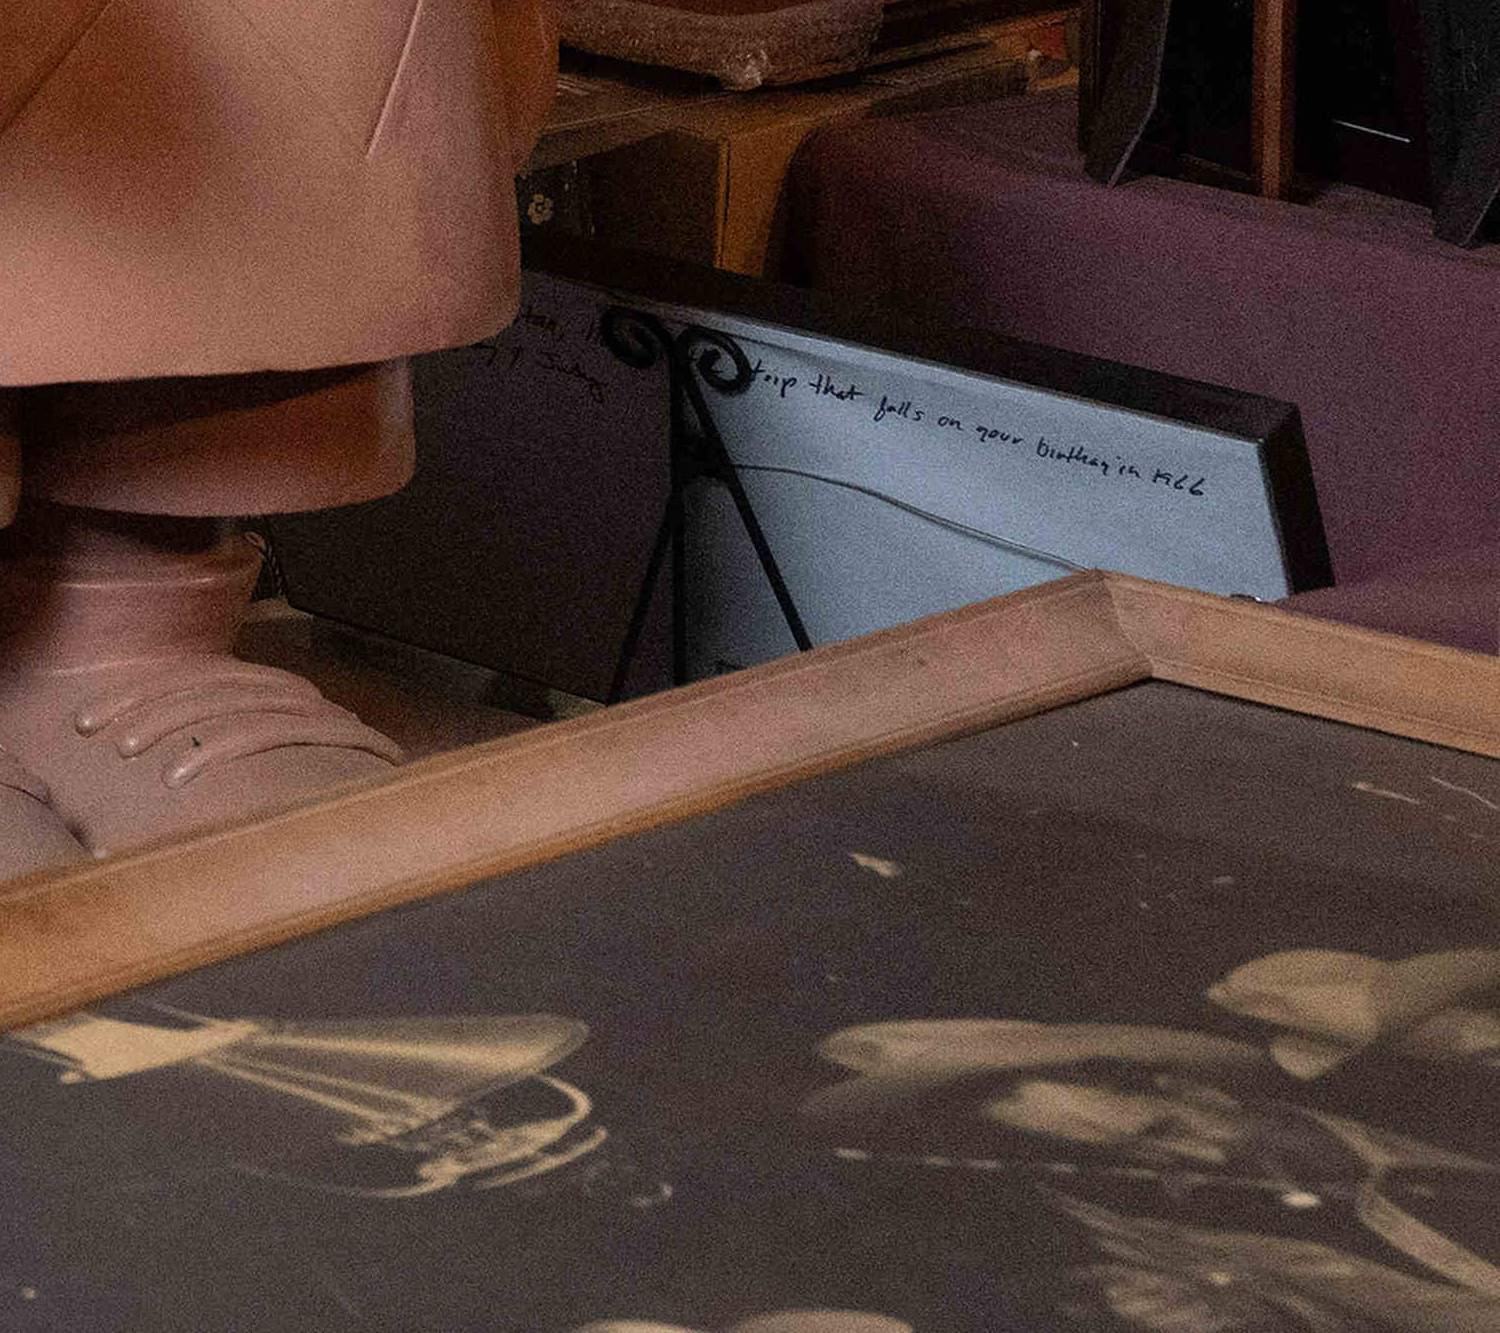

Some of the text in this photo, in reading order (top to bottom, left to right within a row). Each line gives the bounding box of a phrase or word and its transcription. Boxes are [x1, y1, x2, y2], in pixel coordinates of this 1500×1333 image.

[809, 373, 865, 404] that
[874, 390, 926, 425] falls
[936, 411, 964, 433] on
[974, 420, 1025, 450] your
[1116, 456, 1142, 479] in
